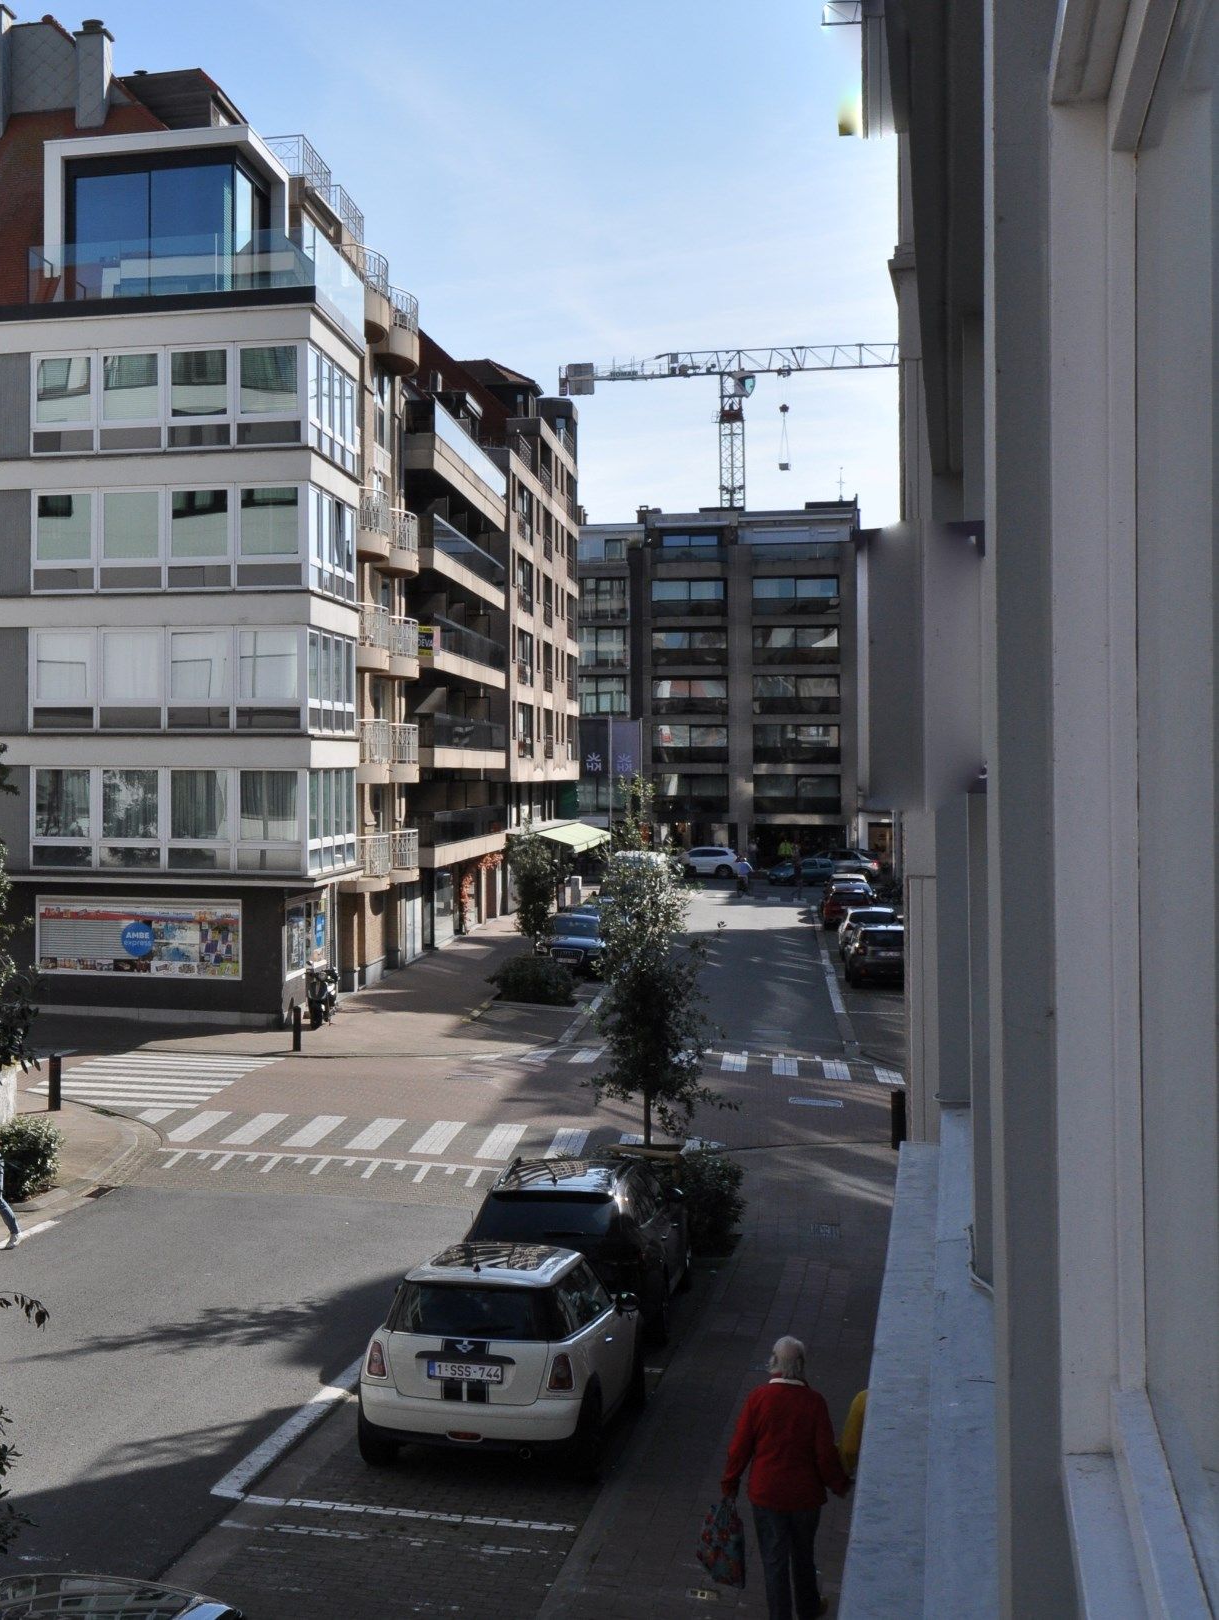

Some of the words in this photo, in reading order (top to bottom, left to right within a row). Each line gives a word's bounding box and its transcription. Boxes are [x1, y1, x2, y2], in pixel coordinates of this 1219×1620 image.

[125, 931, 150, 939] AMBE
[123, 940, 152, 948] express
[437, 1364, 500, 1379] 1-SSS-744
